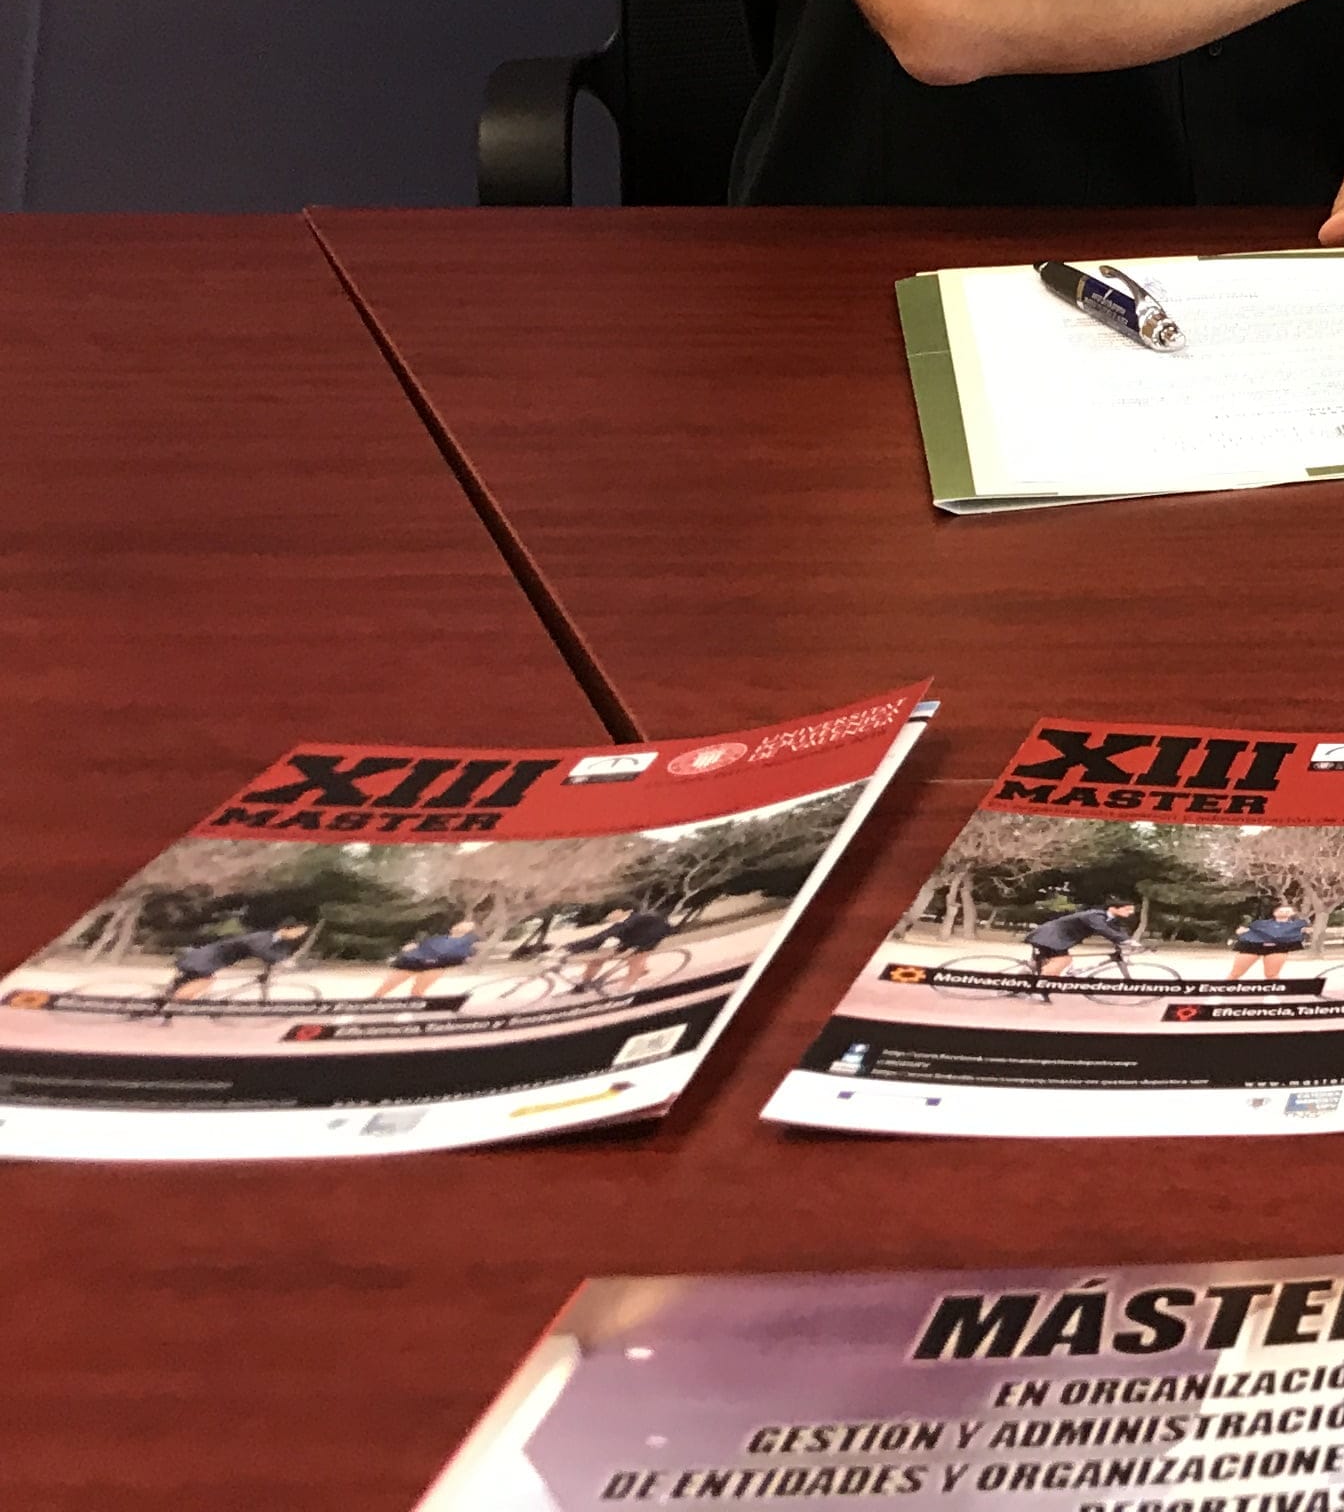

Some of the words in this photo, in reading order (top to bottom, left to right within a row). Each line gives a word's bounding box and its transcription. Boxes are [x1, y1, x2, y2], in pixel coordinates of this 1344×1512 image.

[1012, 728, 1296, 791] XIII
[240, 754, 561, 807] XIII
[996, 780, 1268, 814] MASTER
[210, 807, 503, 832] MASTER
[933, 970, 1032, 988] Motivación,
[1036, 978, 1182, 994] Emprededurismo
[1184, 983, 1195, 995] y
[1199, 982, 1286, 994] Excelencia
[993, 1378, 1047, 1409] EN
[956, 1420, 982, 1449] Y
[600, 1468, 661, 1500] DE
[670, 1462, 929, 1499] ENTIDADES
[939, 1462, 969, 1494] Y
